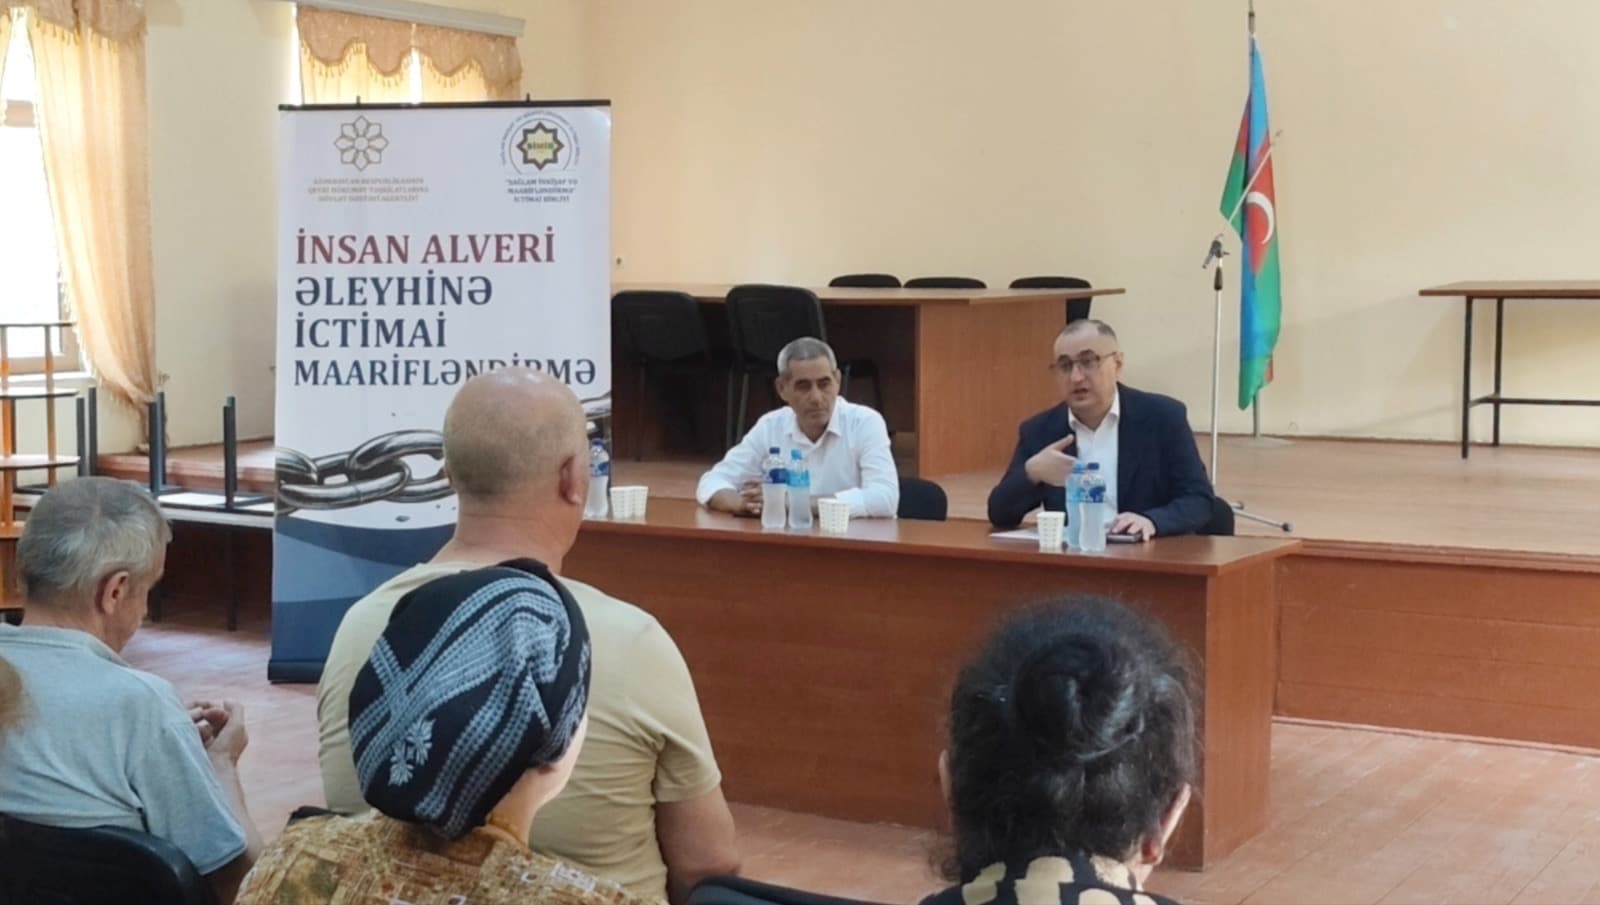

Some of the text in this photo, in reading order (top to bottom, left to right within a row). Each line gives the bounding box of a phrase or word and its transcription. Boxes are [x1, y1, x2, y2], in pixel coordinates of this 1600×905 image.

[296, 226, 555, 264] İNSAN ALVERİ
[295, 269, 492, 306] ƏLEYHİNƏ
[295, 311, 447, 348] İCTİMAİ
